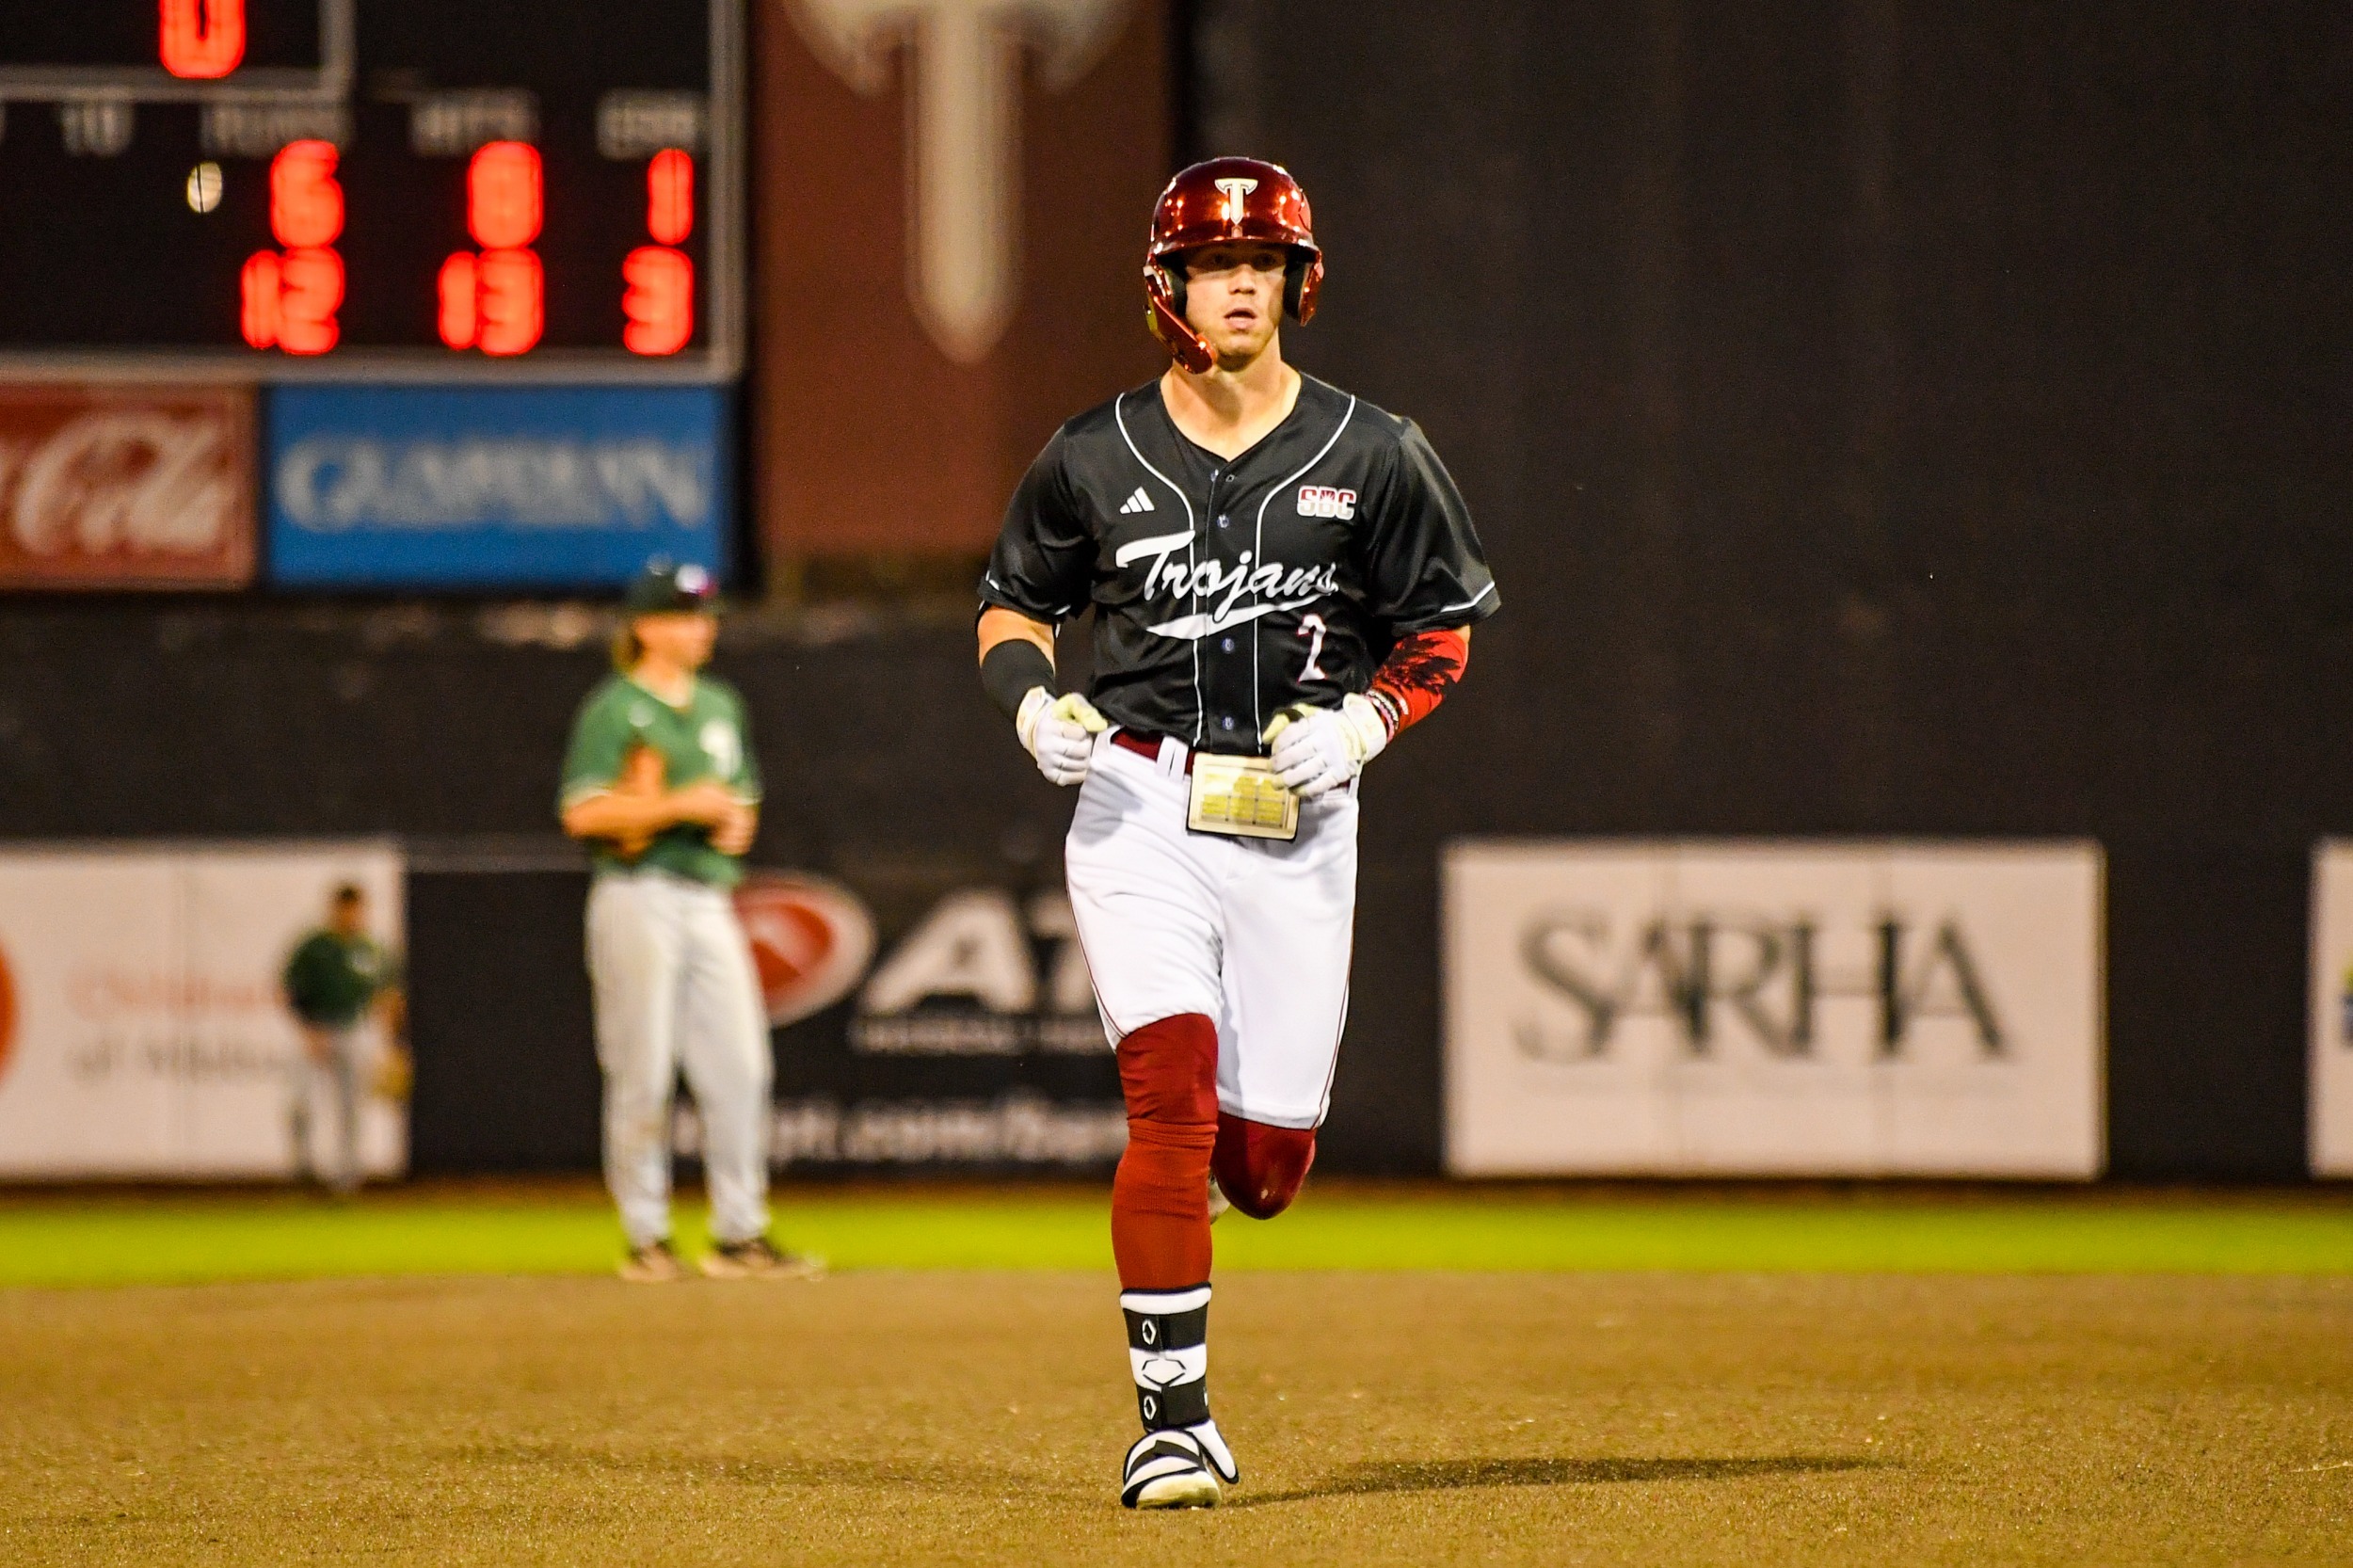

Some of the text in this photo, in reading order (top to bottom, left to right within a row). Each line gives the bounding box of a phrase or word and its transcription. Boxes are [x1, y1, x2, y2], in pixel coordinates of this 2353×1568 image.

[270, 139, 344, 247] 6
[241, 246, 693, 356] 12 13 3
[1296, 485, 1357, 520] SBC
[1115, 530, 1338, 623] Trojans
[1297, 614, 1328, 684] 2
[1513, 901, 2016, 1066] SARHA
